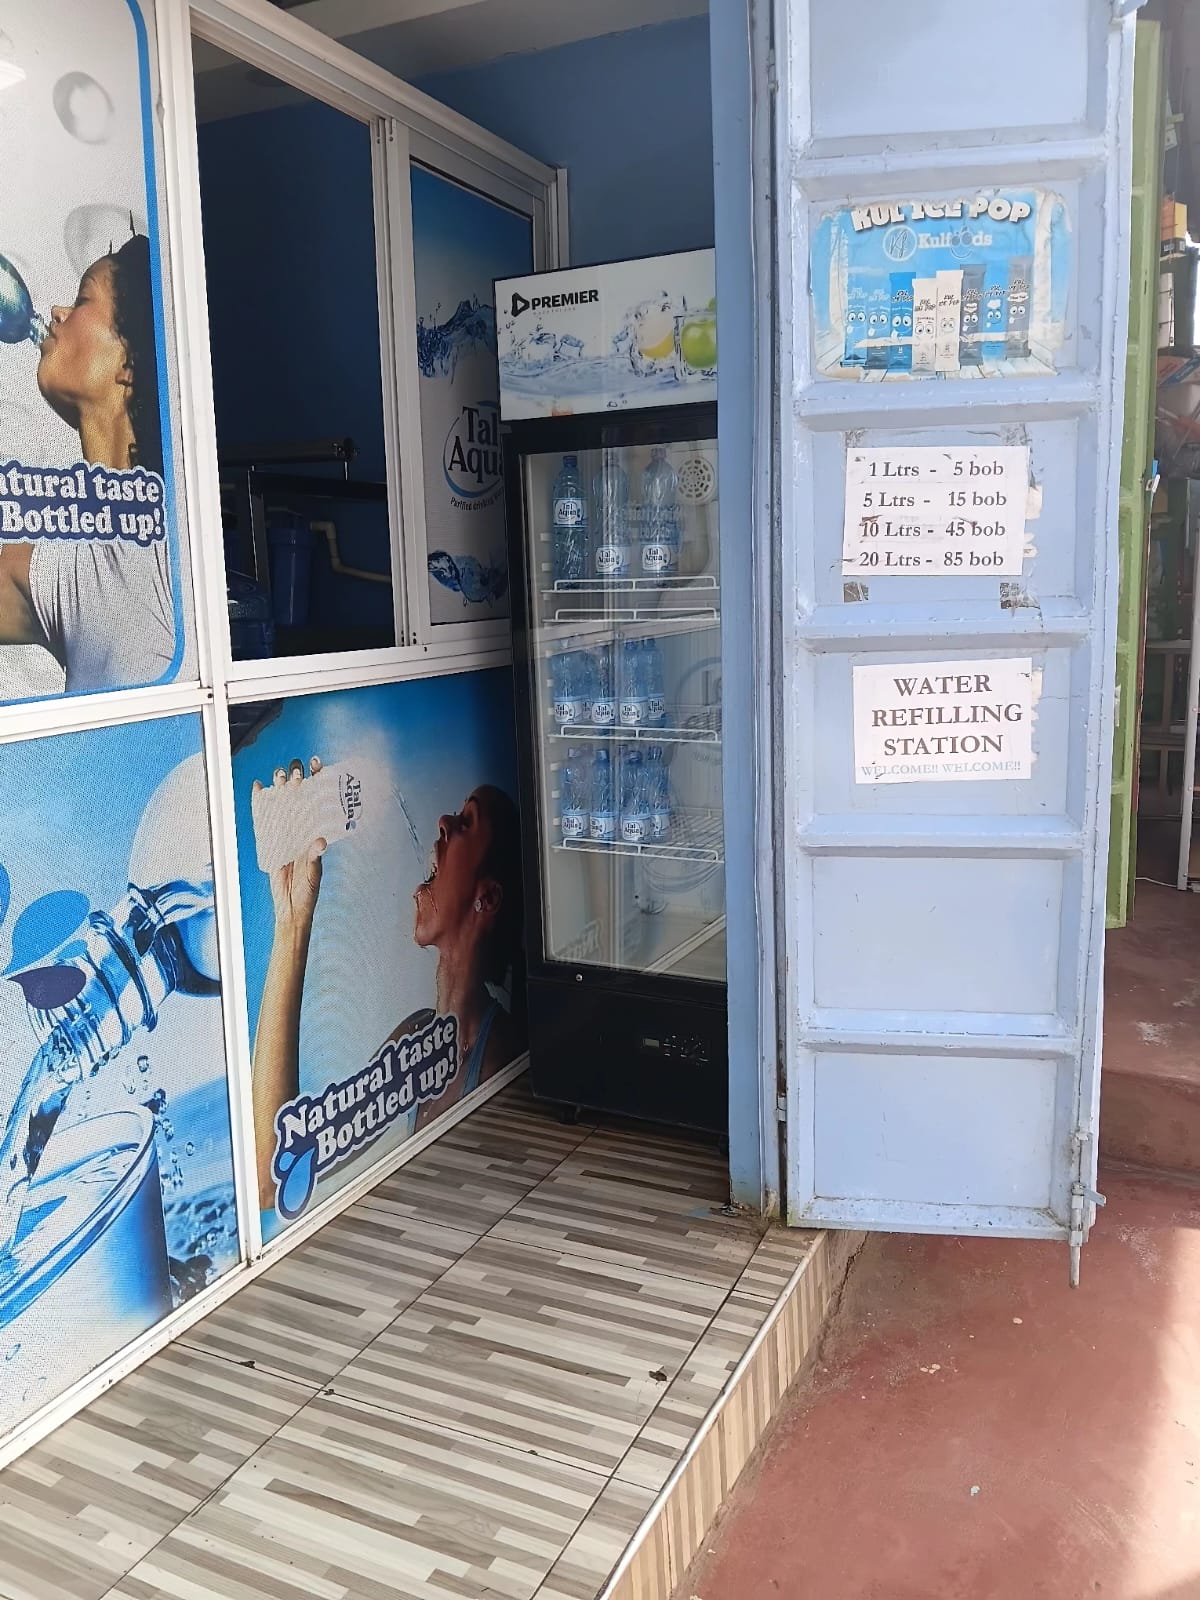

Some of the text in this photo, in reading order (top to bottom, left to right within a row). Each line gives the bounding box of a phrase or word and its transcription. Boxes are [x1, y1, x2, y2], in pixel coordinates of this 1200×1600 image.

[968, 197, 1031, 222] POP
[531, 289, 599, 311] PREMIER
[462, 406, 498, 446] Tal
[869, 462, 877, 477] 1
[882, 461, 920, 477] Ltrs
[953, 461, 963, 476] 5
[969, 460, 1004, 476] bob
[92, 473, 159, 502] taste
[863, 492, 873, 507] 5
[878, 492, 915, 507] Ltrs
[948, 491, 966, 506] 15
[972, 491, 1007, 506] bob
[0, 500, 161, 541] Bottled up!
[862, 522, 879, 537] 10
[884, 521, 921, 537] Ltrs
[945, 522, 965, 537] 45
[971, 520, 1006, 537] bob
[859, 551, 879, 567] 20
[885, 551, 921, 567] Ltrs
[943, 551, 963, 567] 85
[969, 551, 1004, 567] bob
[893, 674, 993, 696] WATER
[871, 703, 1024, 727] REFILLING
[884, 734, 1003, 757] STATION
[861, 761, 1021, 777] WELCOME!! WELCOME!!
[345, 773, 355, 819] Aqua
[353, 780, 361, 808] Tal
[282, 1022, 454, 1148] Natural taste
[316, 1046, 455, 1165] Bottled up!
